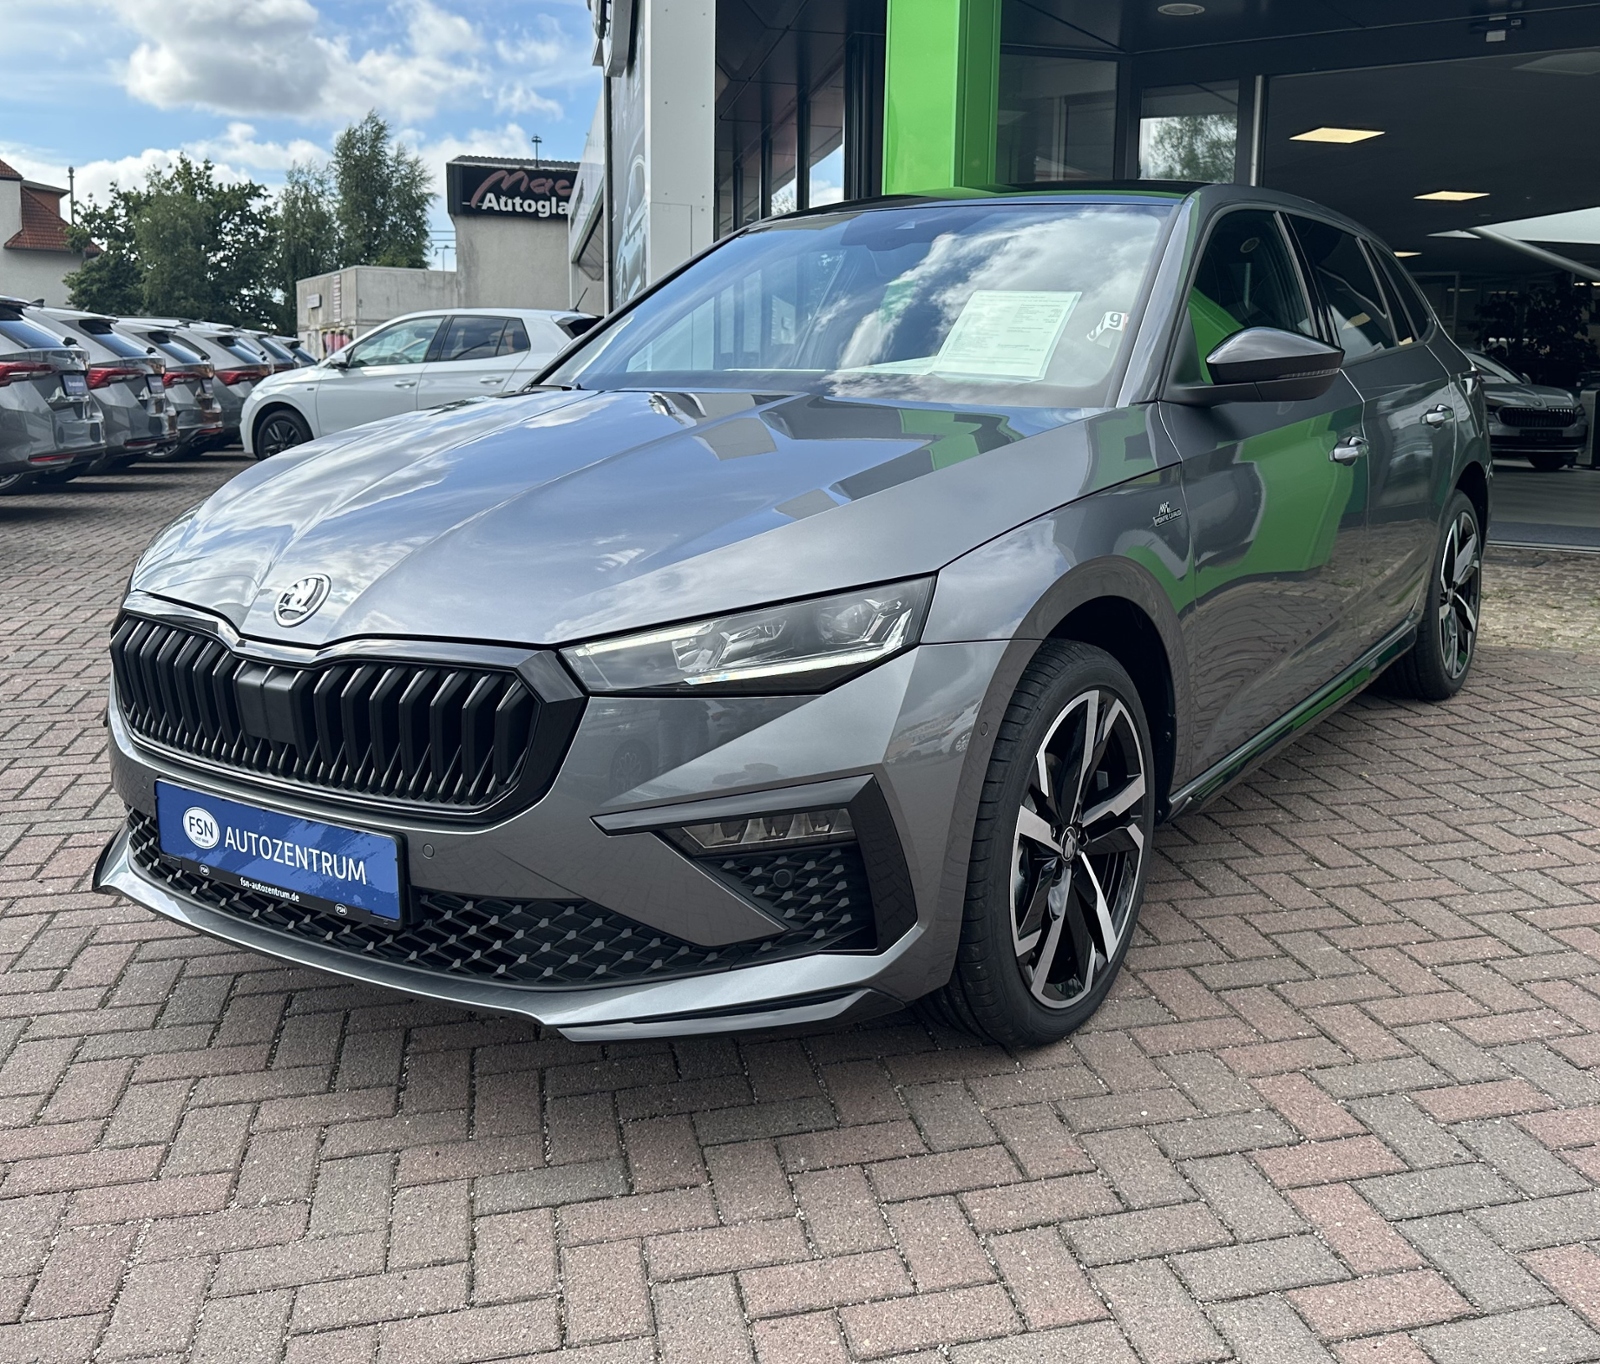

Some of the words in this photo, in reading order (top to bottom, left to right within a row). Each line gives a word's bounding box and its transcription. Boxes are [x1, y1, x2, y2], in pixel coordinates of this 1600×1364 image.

[188, 815, 214, 839] FSN
[224, 826, 367, 885] AUTOZENTRUM
[240, 876, 300, 903] fsn-autozentrum.de
